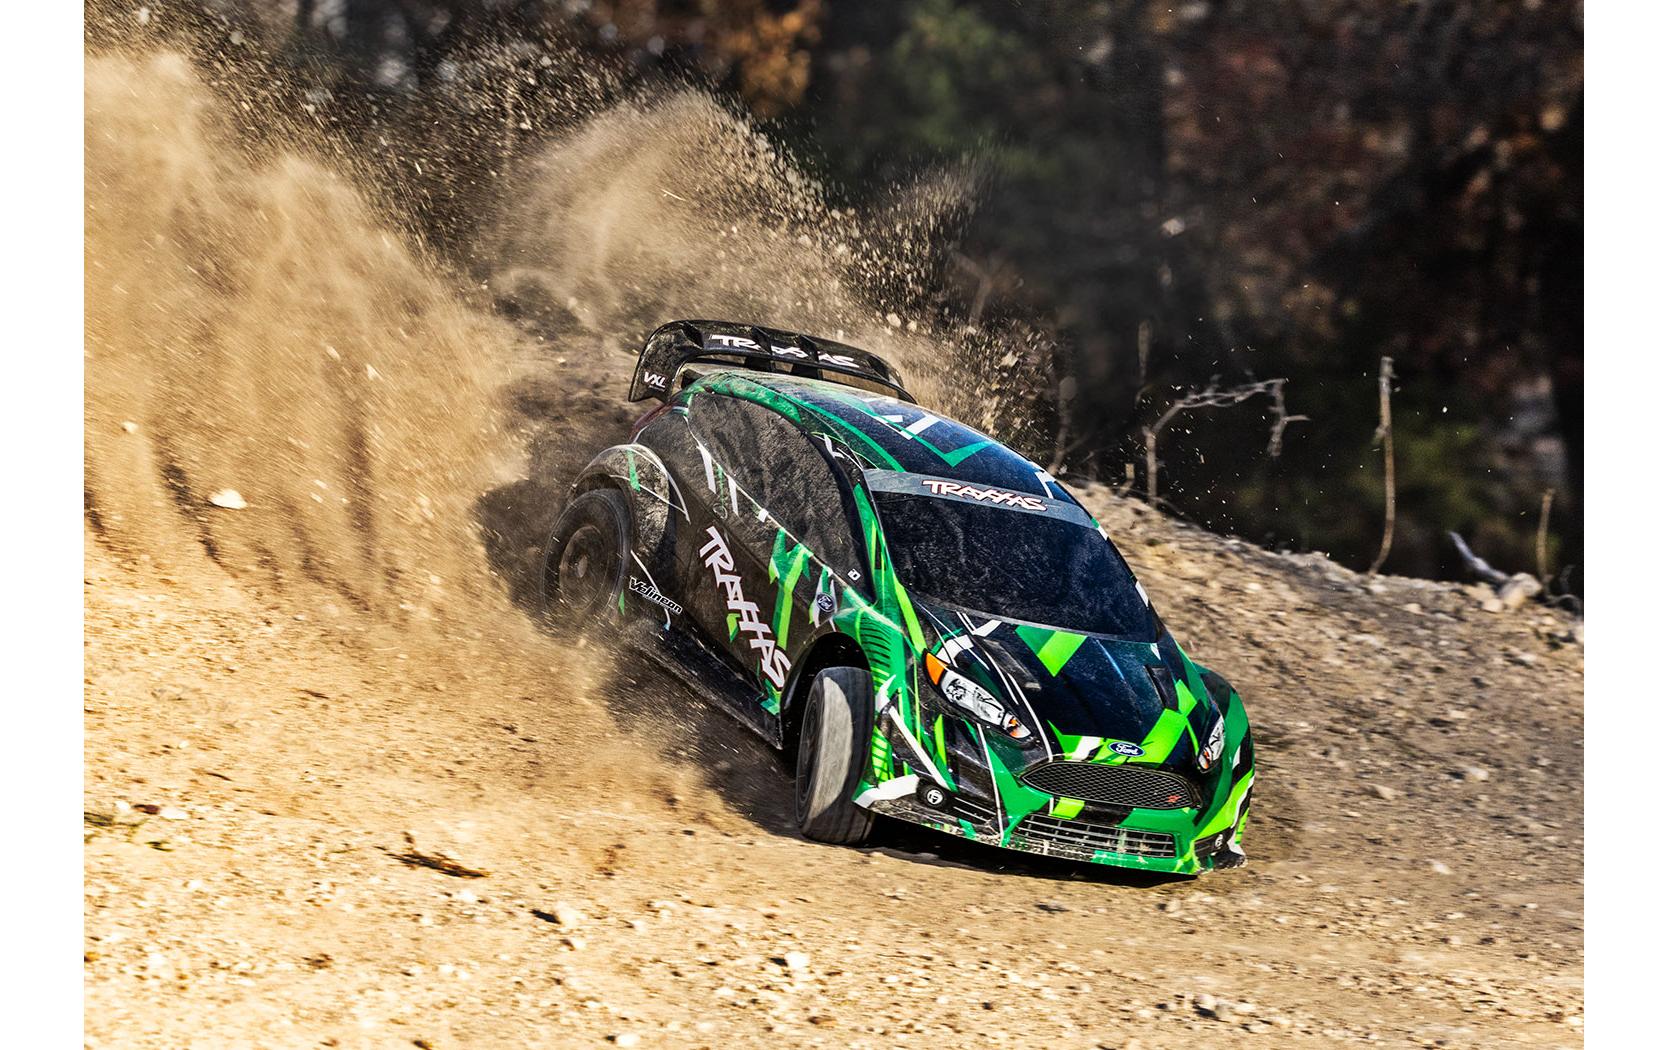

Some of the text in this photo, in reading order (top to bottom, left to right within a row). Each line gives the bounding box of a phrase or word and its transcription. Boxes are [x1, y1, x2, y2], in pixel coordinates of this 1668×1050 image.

[644, 371, 666, 388] VXL
[922, 480, 1048, 511] TRAXXAS
[629, 575, 683, 615] Velineon
[699, 525, 792, 688] TRAXXAS
